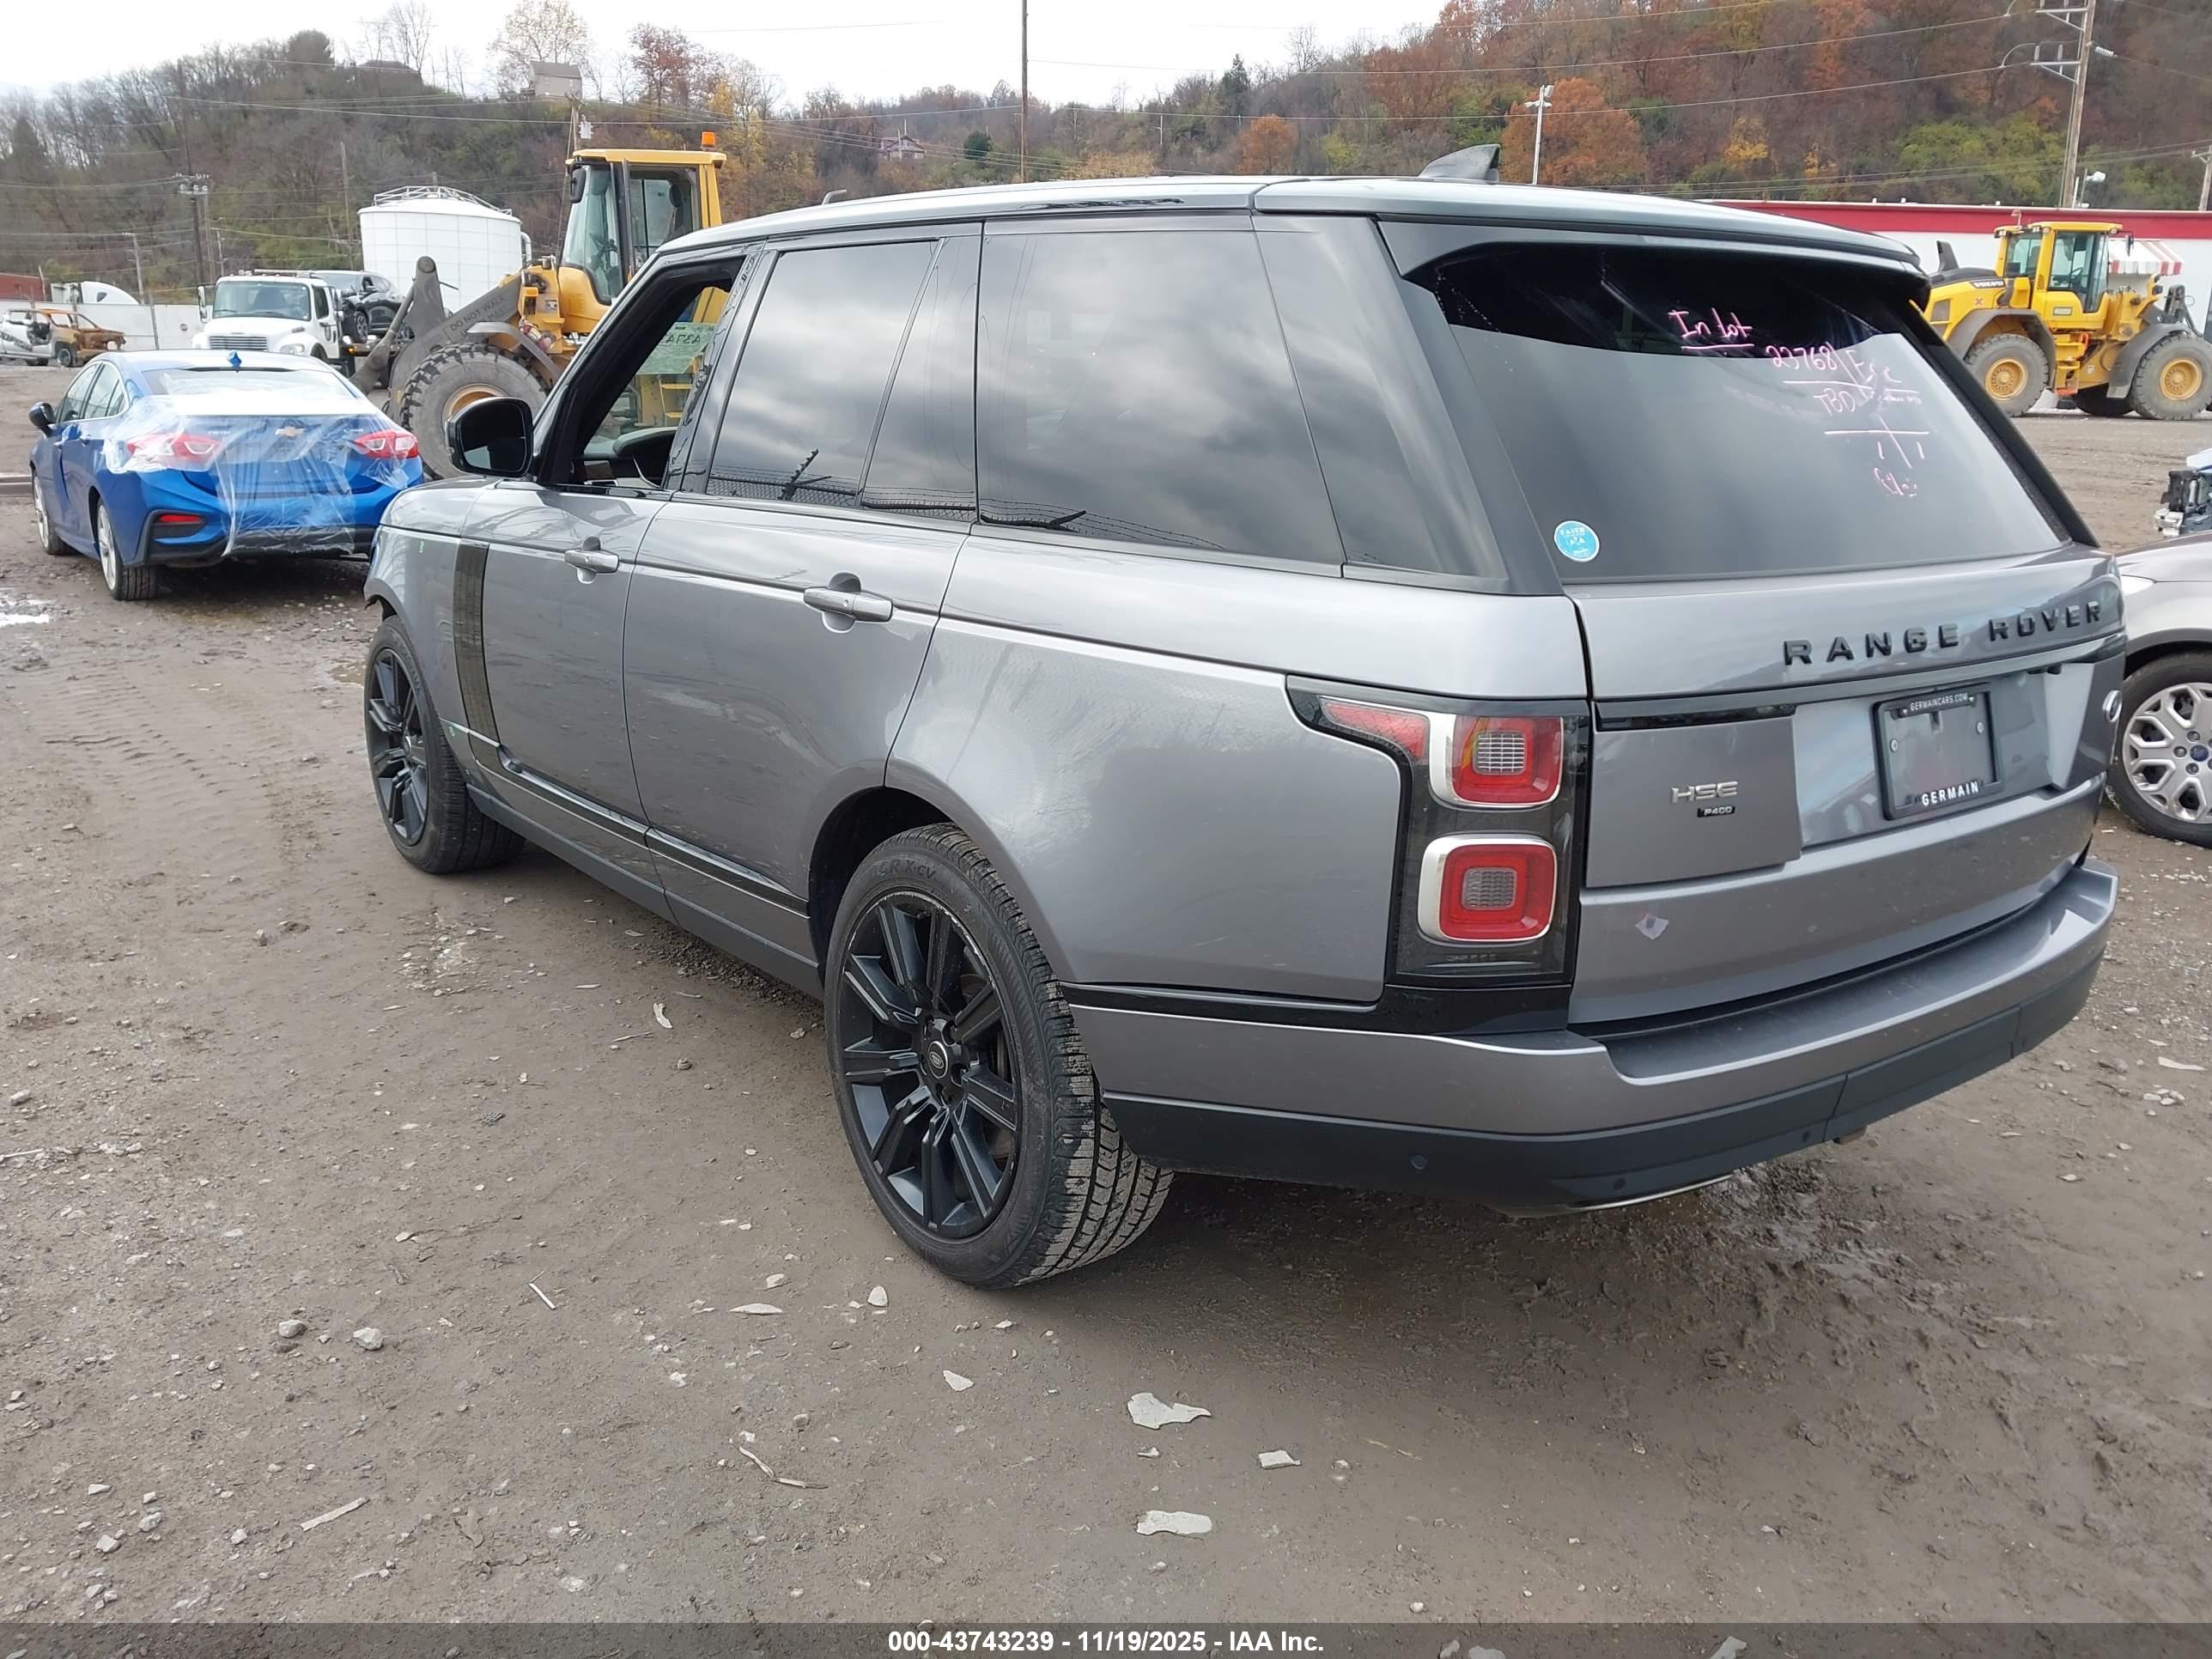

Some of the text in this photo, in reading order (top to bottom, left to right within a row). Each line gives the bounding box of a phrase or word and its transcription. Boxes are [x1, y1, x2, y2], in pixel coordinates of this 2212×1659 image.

[1668, 310, 1711, 337] In
[1783, 601, 2100, 665] RANGE ROVER
[1910, 693, 1968, 712] GERMAINCARS.COM
[1671, 781, 1739, 803] HSE
[1922, 781, 1978, 807] GERMAIN
[1704, 805, 1733, 817] P400
